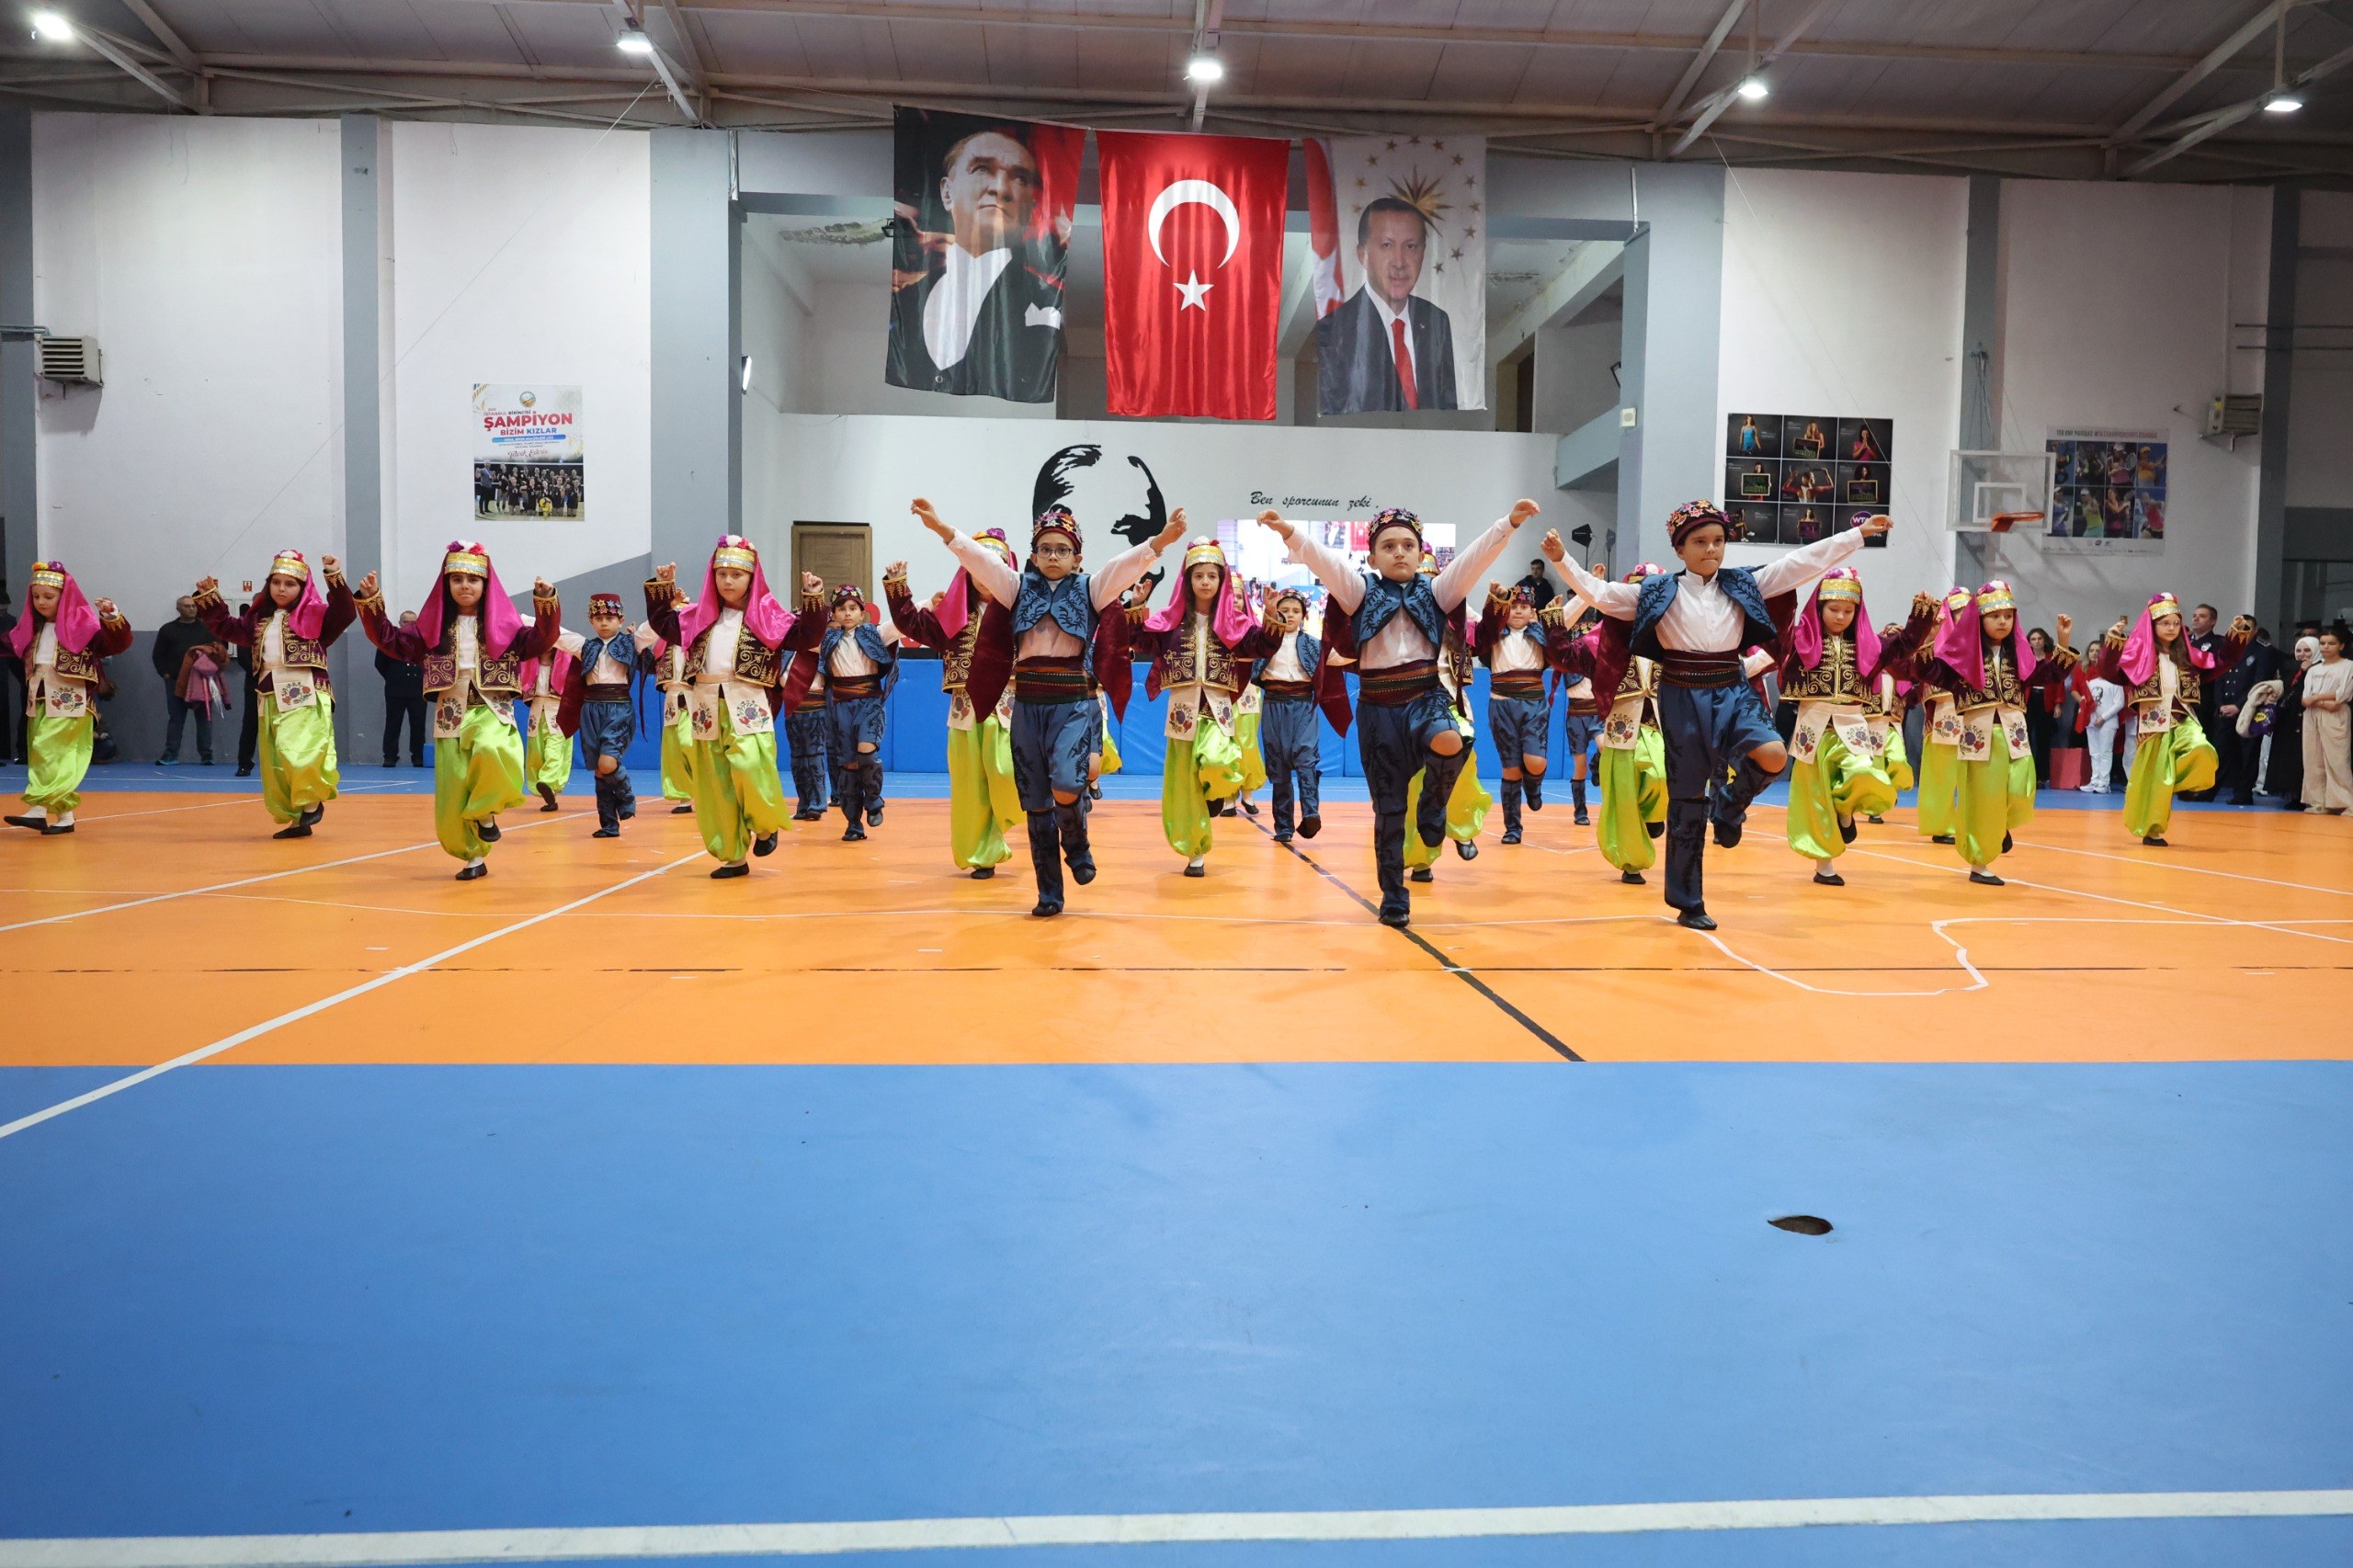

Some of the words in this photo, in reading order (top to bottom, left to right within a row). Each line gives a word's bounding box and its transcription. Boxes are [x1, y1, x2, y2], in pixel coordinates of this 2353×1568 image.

[483, 411, 573, 431] ŞAMPİYON
[1250, 491, 1273, 505] Ben
[1282, 495, 1339, 508] sporcunun
